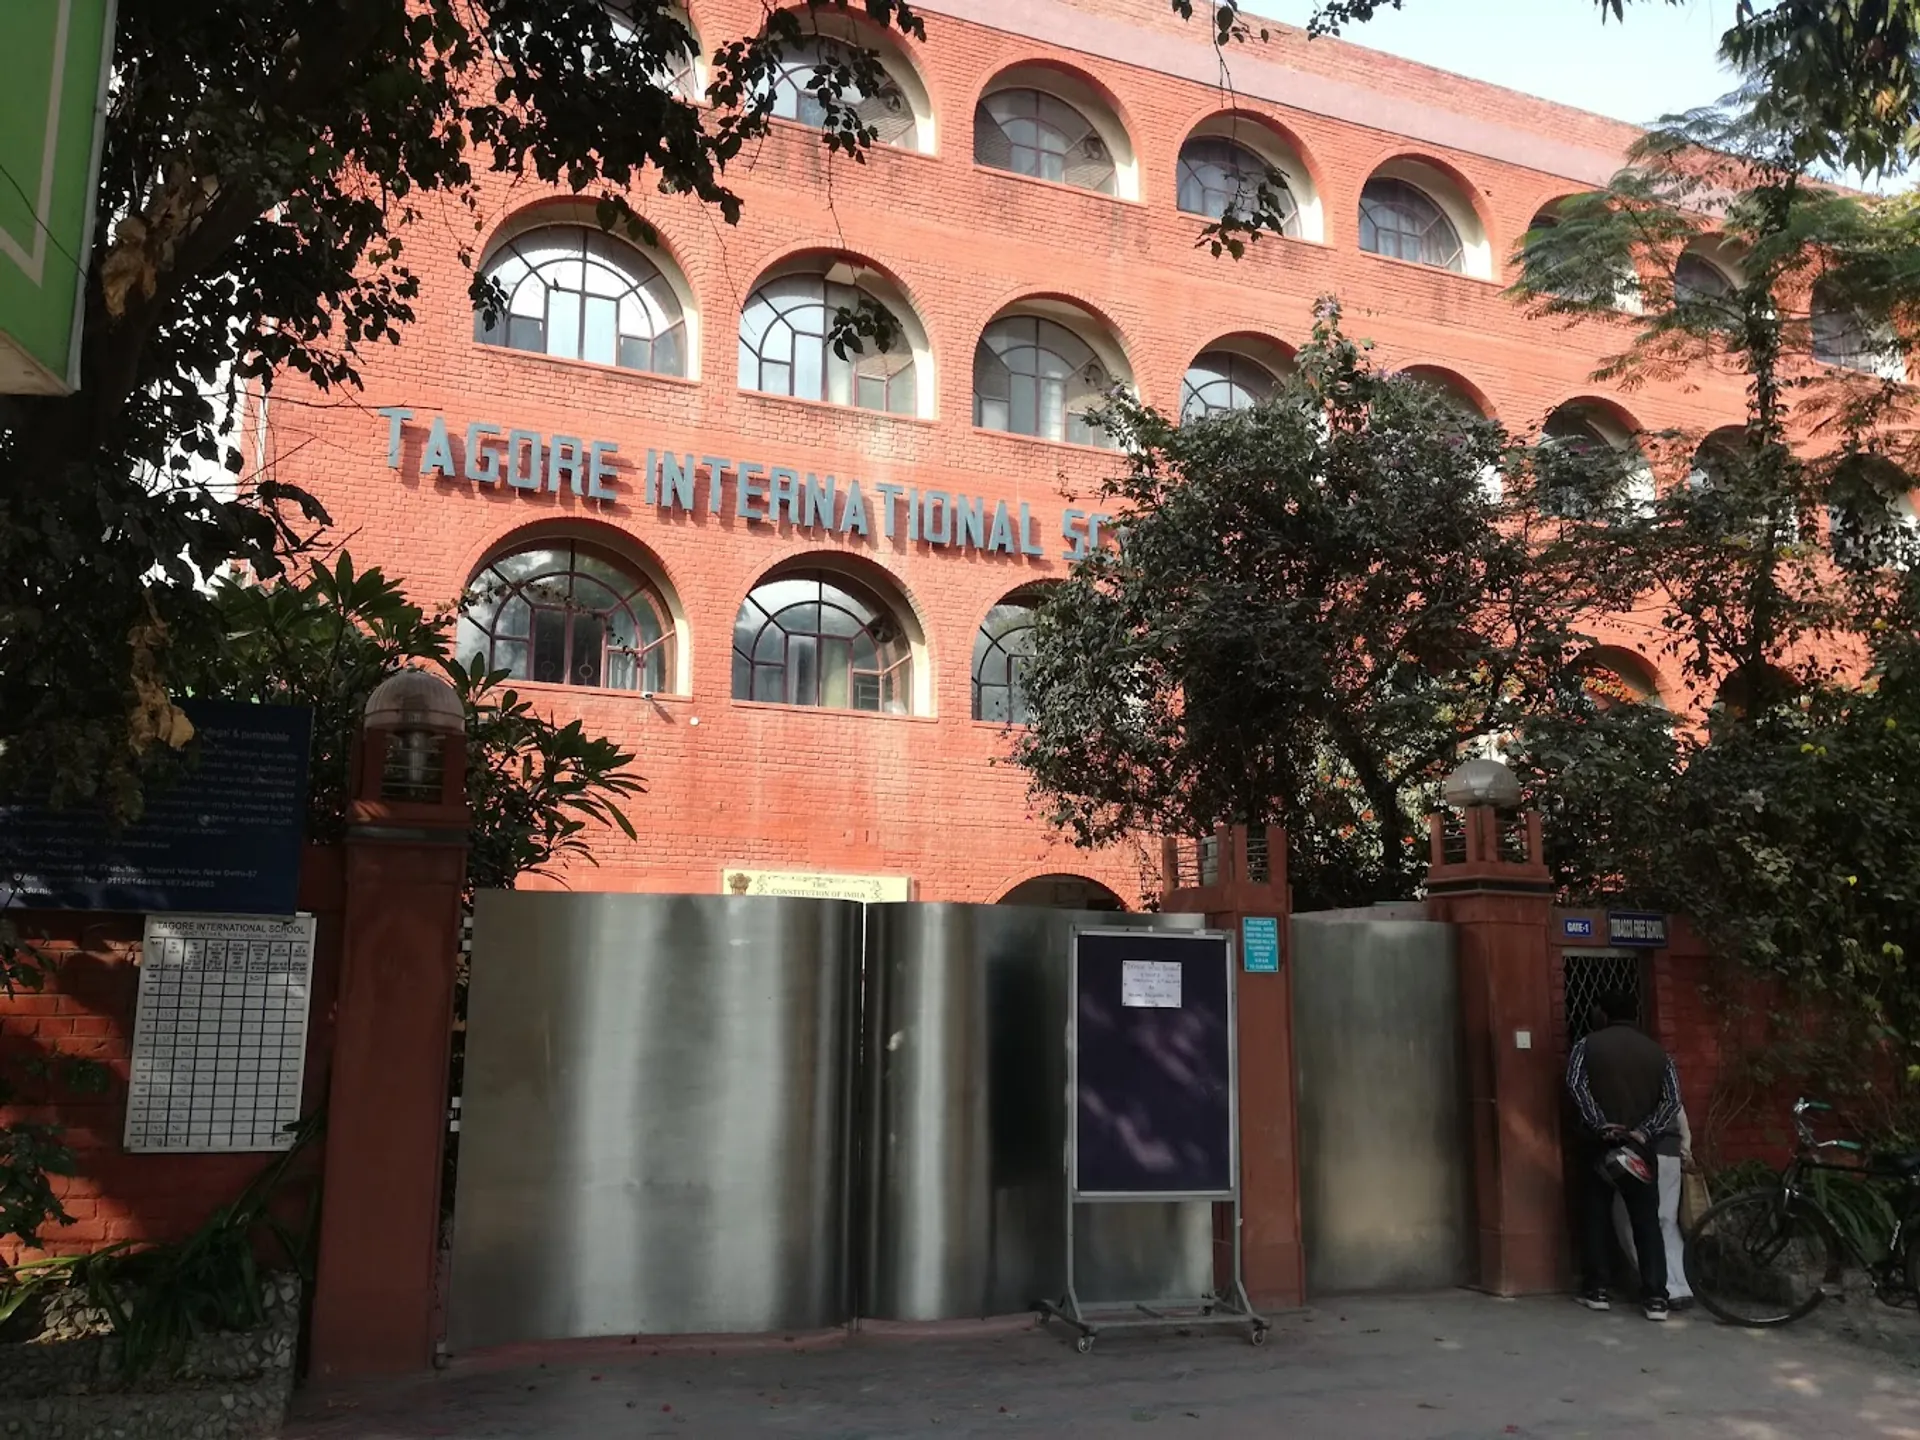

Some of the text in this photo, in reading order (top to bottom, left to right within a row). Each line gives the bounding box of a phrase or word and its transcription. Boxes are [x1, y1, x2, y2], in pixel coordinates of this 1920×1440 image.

[377, 407, 618, 501] TAGORE
[645, 448, 1043, 557] INTERNATIONAL
[771, 888, 832, 897] CONSTITUTION
[843, 891, 866, 899] INDIA
[158, 920, 305, 935] TAGORE INTERNATIONAL SCHOOL
[1567, 922, 1589, 933] GATE-1
